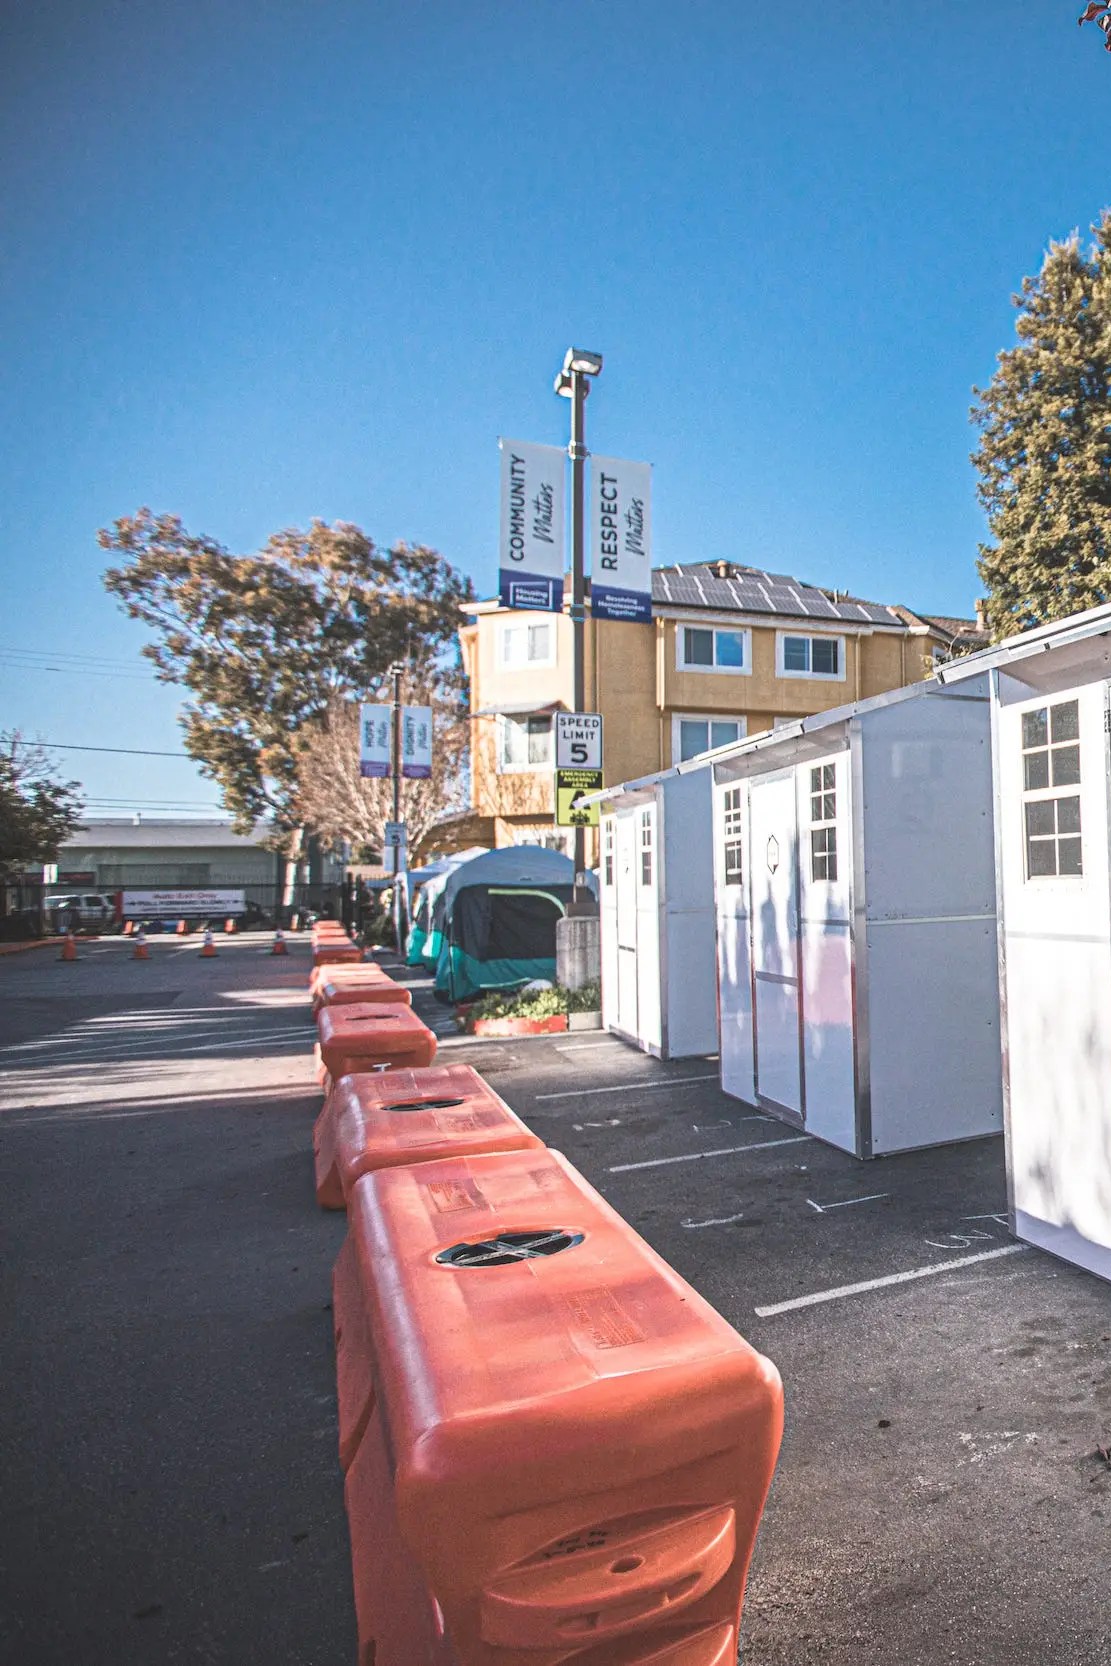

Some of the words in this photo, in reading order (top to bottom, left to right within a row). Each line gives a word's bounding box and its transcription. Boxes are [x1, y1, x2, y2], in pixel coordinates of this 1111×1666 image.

[510, 453, 526, 561] COMMUNITY
[532, 482, 554, 543] Matters
[600, 471, 618, 571] RESPECT
[624, 497, 645, 556] Matters
[515, 587, 549, 599] Housing
[560, 717, 599, 728] SPEED
[563, 730, 595, 740] LIMIT
[570, 743, 588, 763] 5
[560, 770, 599, 779] EMERGENCY
